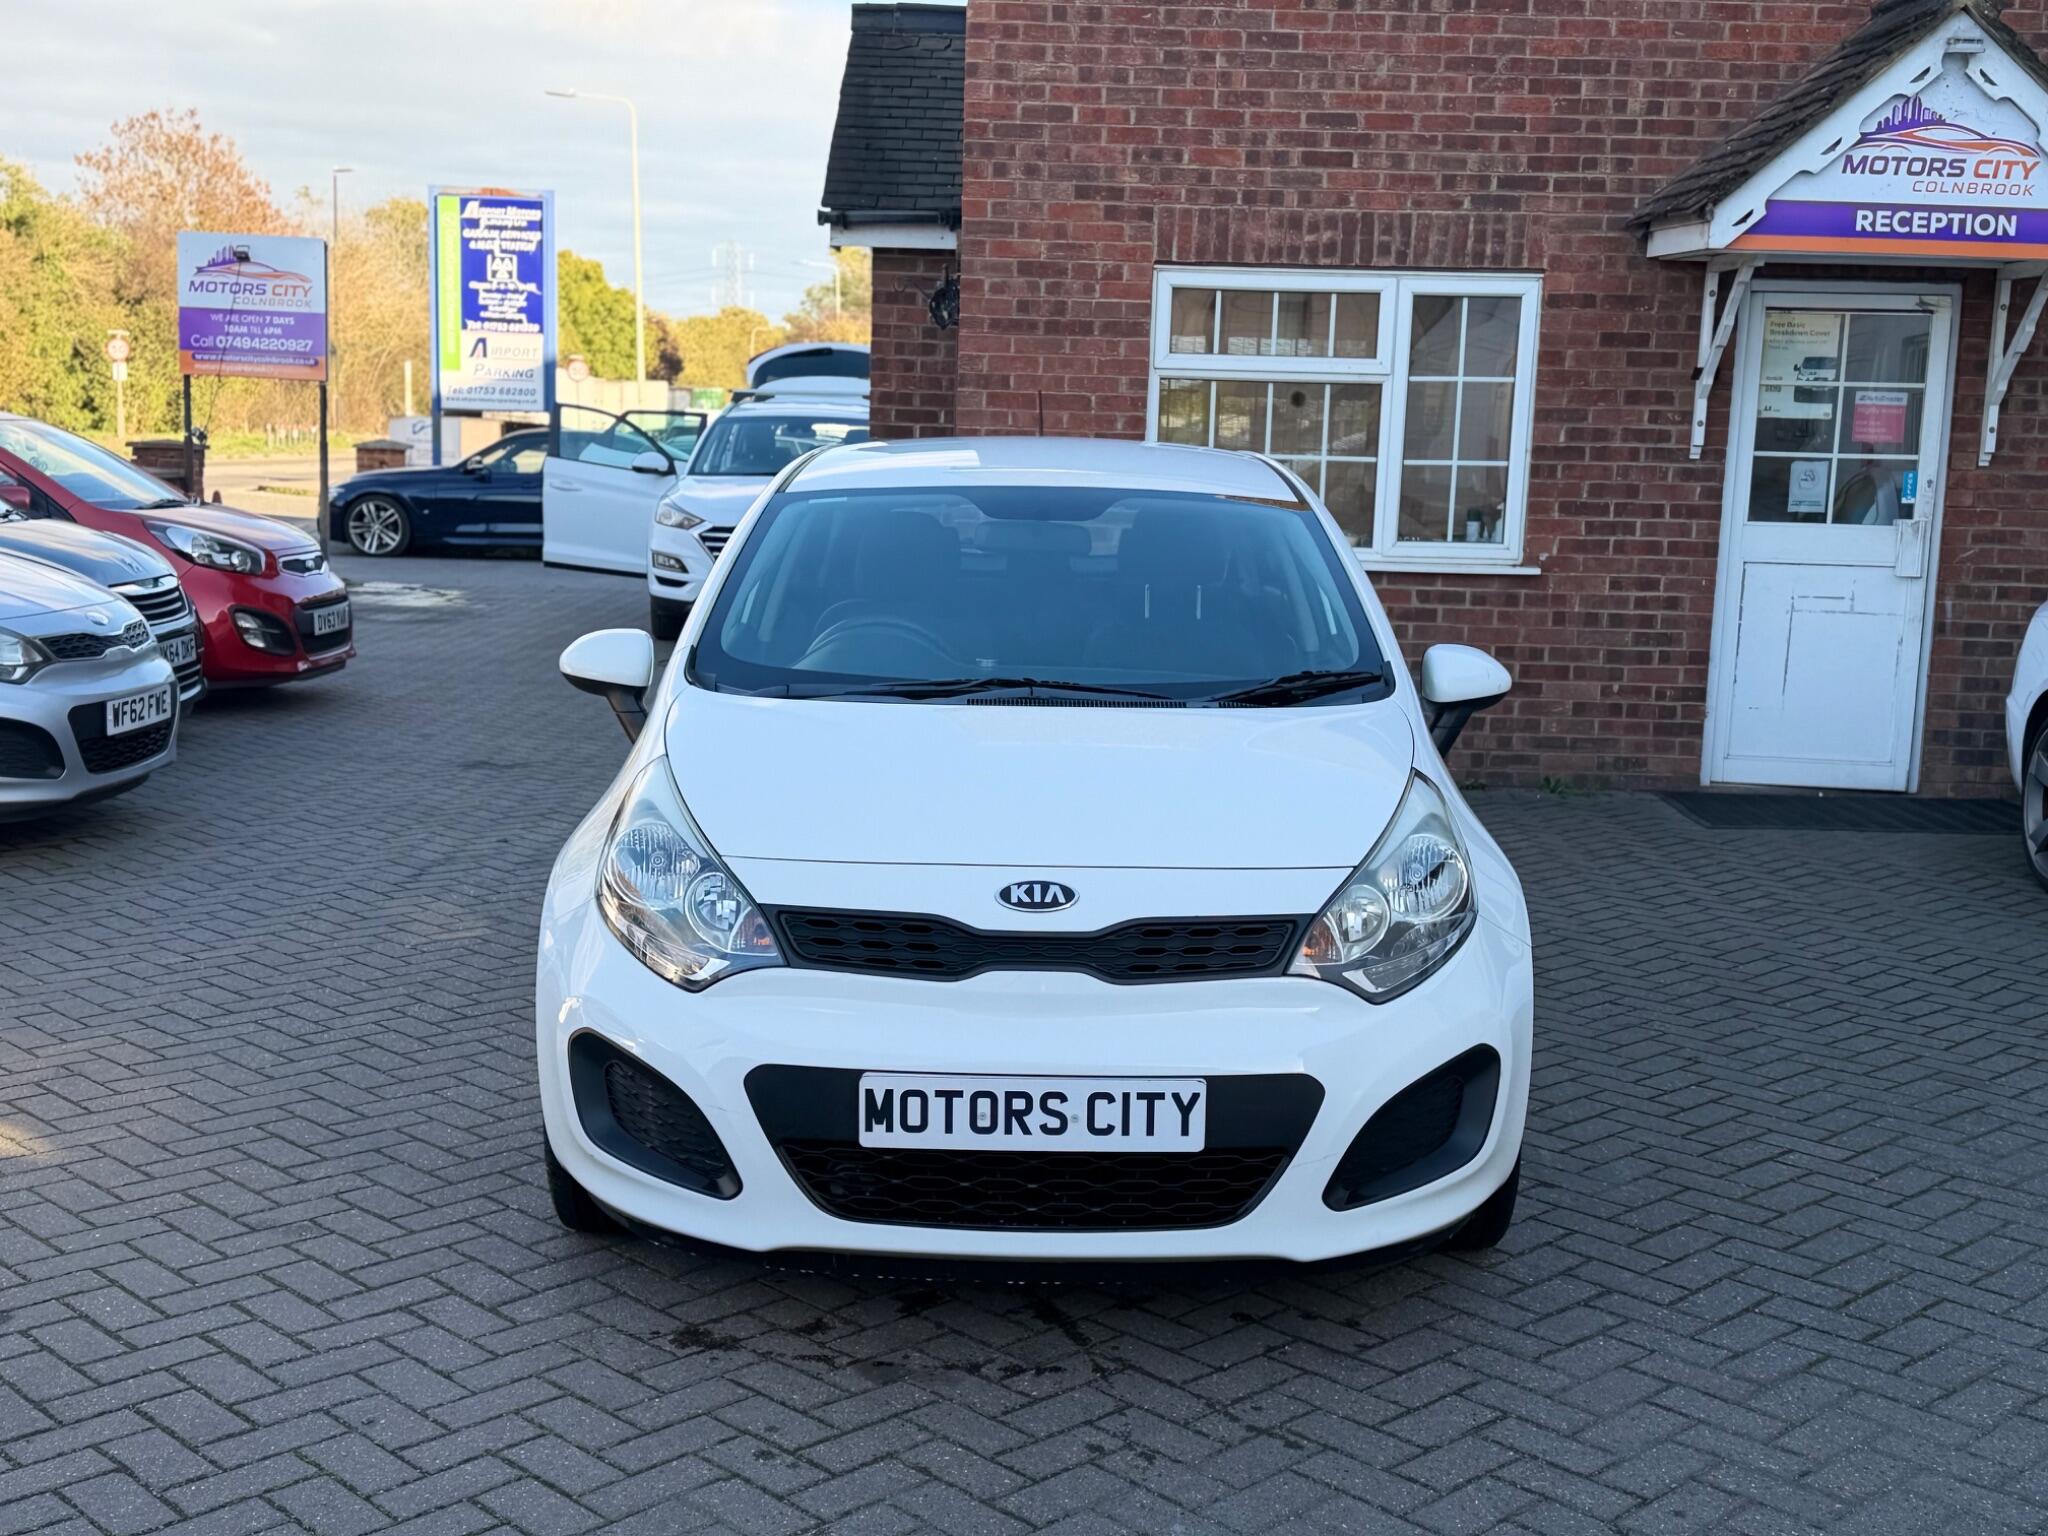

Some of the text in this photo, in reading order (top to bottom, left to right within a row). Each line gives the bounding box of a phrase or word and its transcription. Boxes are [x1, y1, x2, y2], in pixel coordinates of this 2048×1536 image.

[1841, 154, 2041, 180] MOTORS CITY
[1912, 180, 2035, 196] COLNBROOK
[1855, 209, 2017, 237] RECEPTION
[188, 280, 313, 297] MOTORS CITY
[234, 297, 312, 308] COLNBROOK
[272, 316, 295, 325] DAYS
[190, 334, 313, 352] Call 07494220927
[112, 690, 168, 728] WF62 FWE
[1010, 883, 1066, 904] KIA
[864, 1088, 1201, 1137] MOTORS CITY
